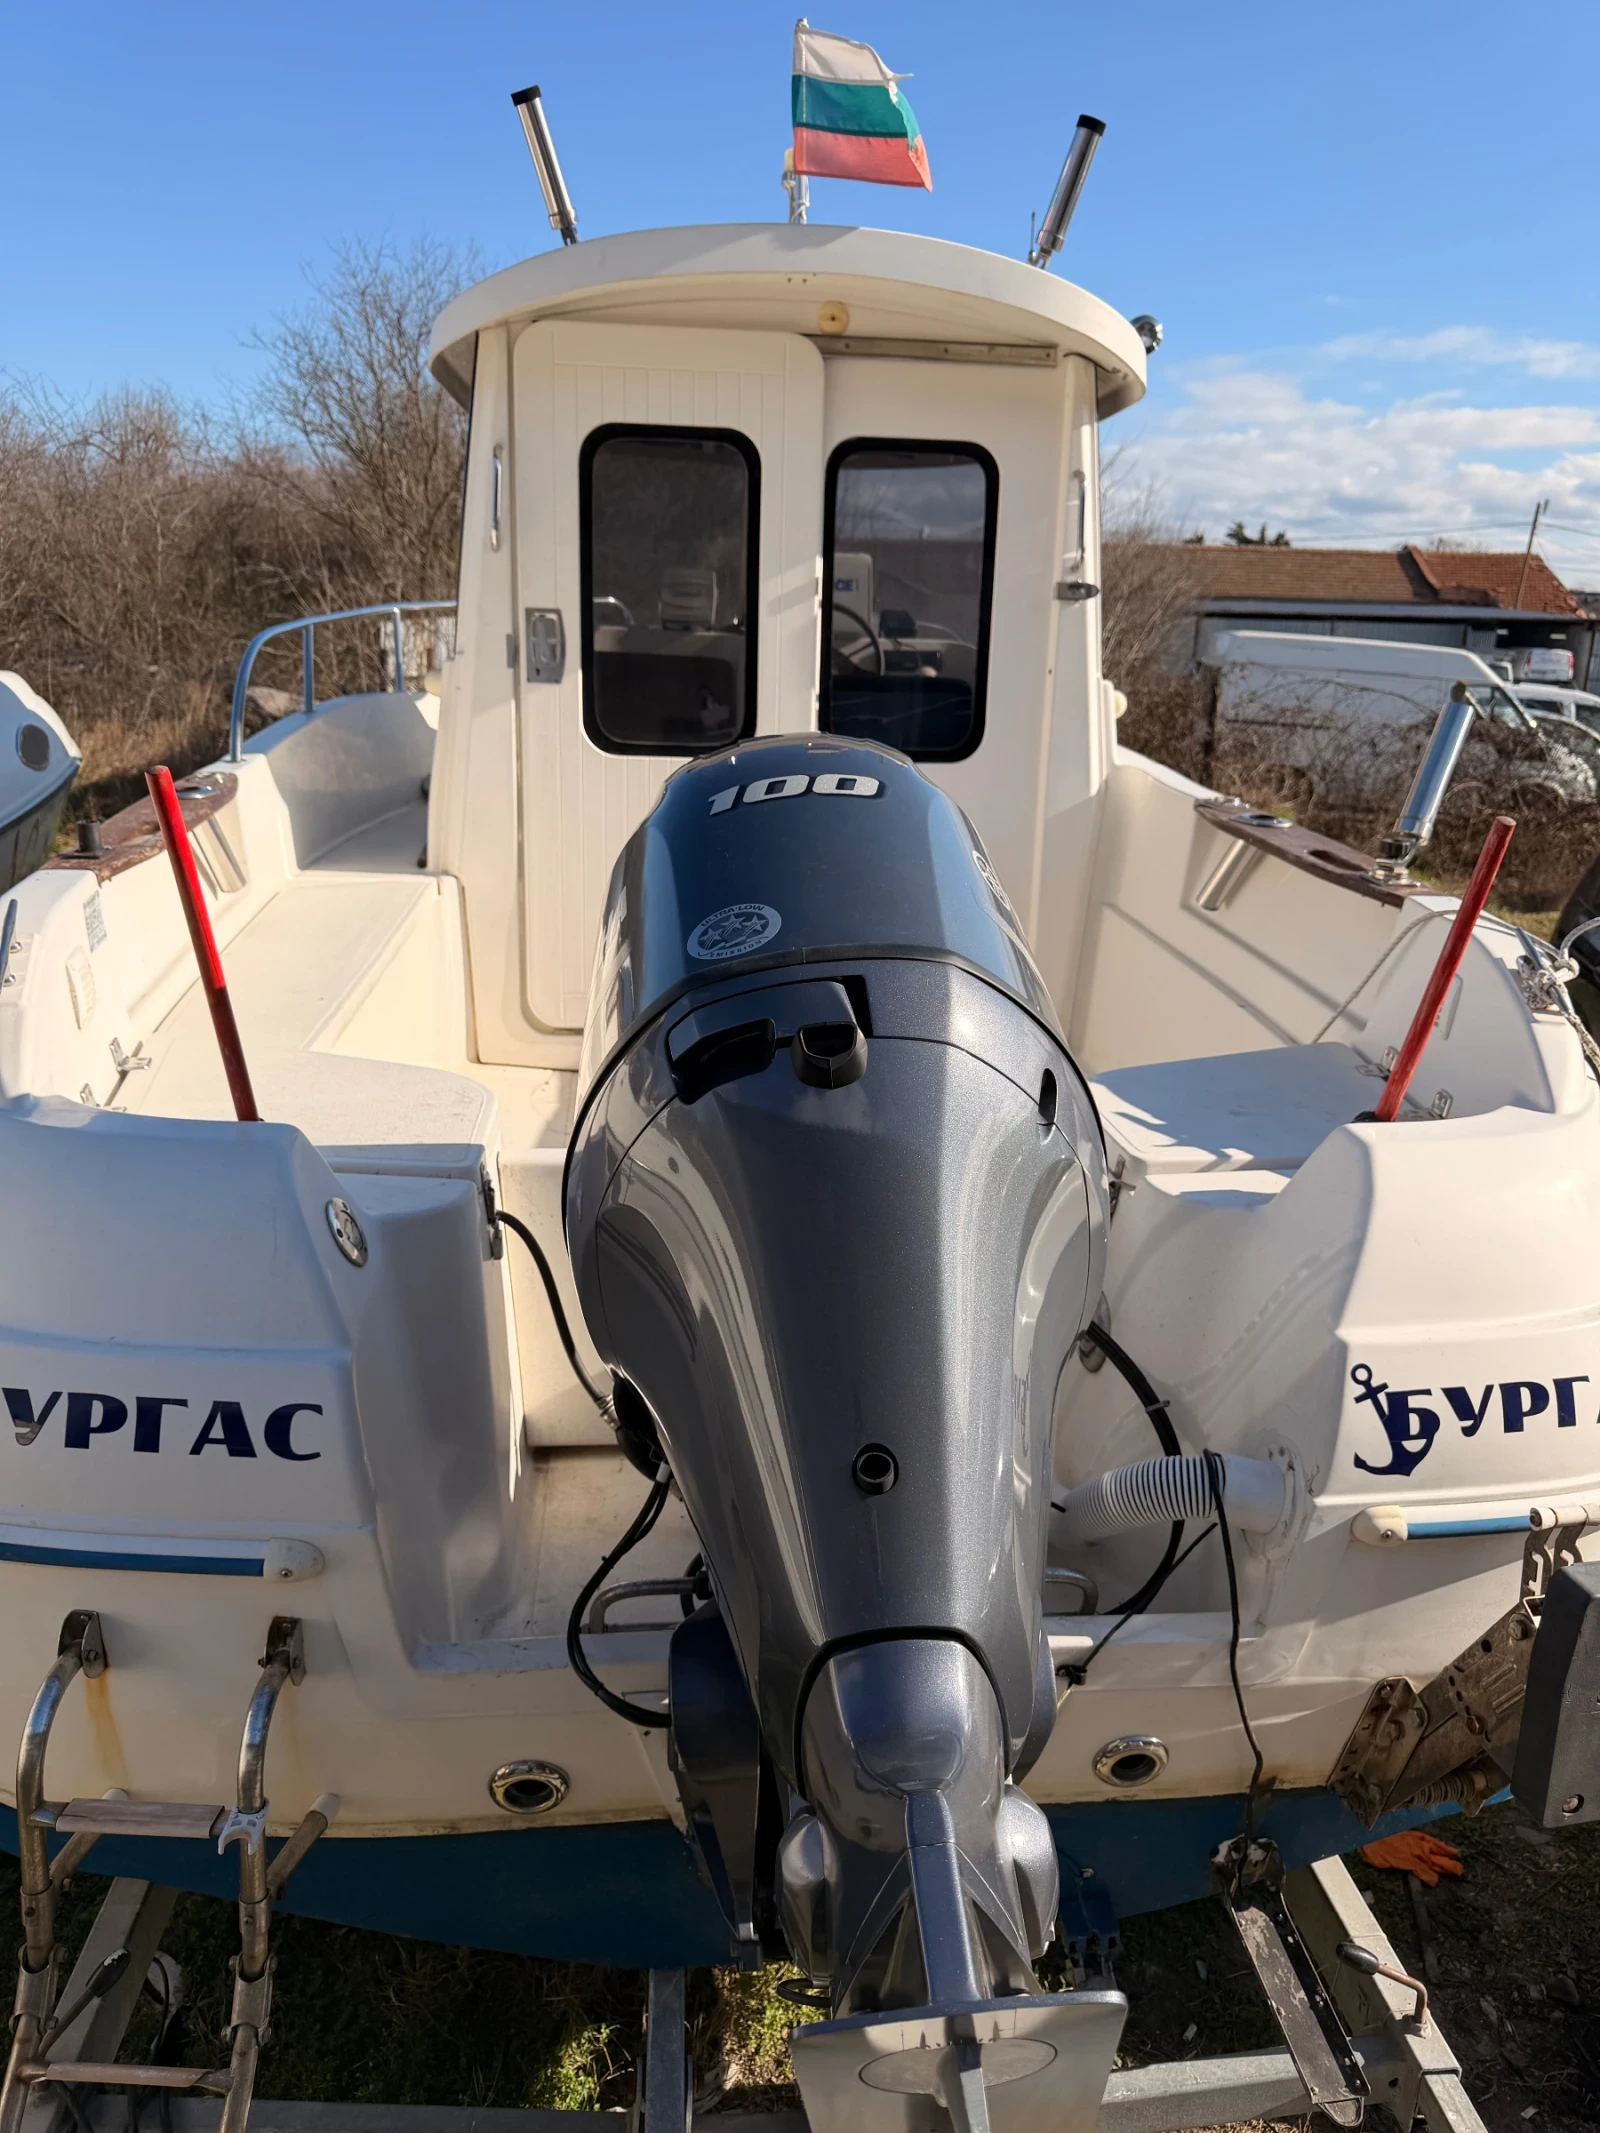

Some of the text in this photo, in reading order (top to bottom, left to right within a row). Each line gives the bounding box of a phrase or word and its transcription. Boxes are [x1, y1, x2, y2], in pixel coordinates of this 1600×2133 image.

[708, 773, 882, 816] 100
[709, 939, 762, 958] EMISSION
[1384, 1375, 1600, 1442] БУРГ
